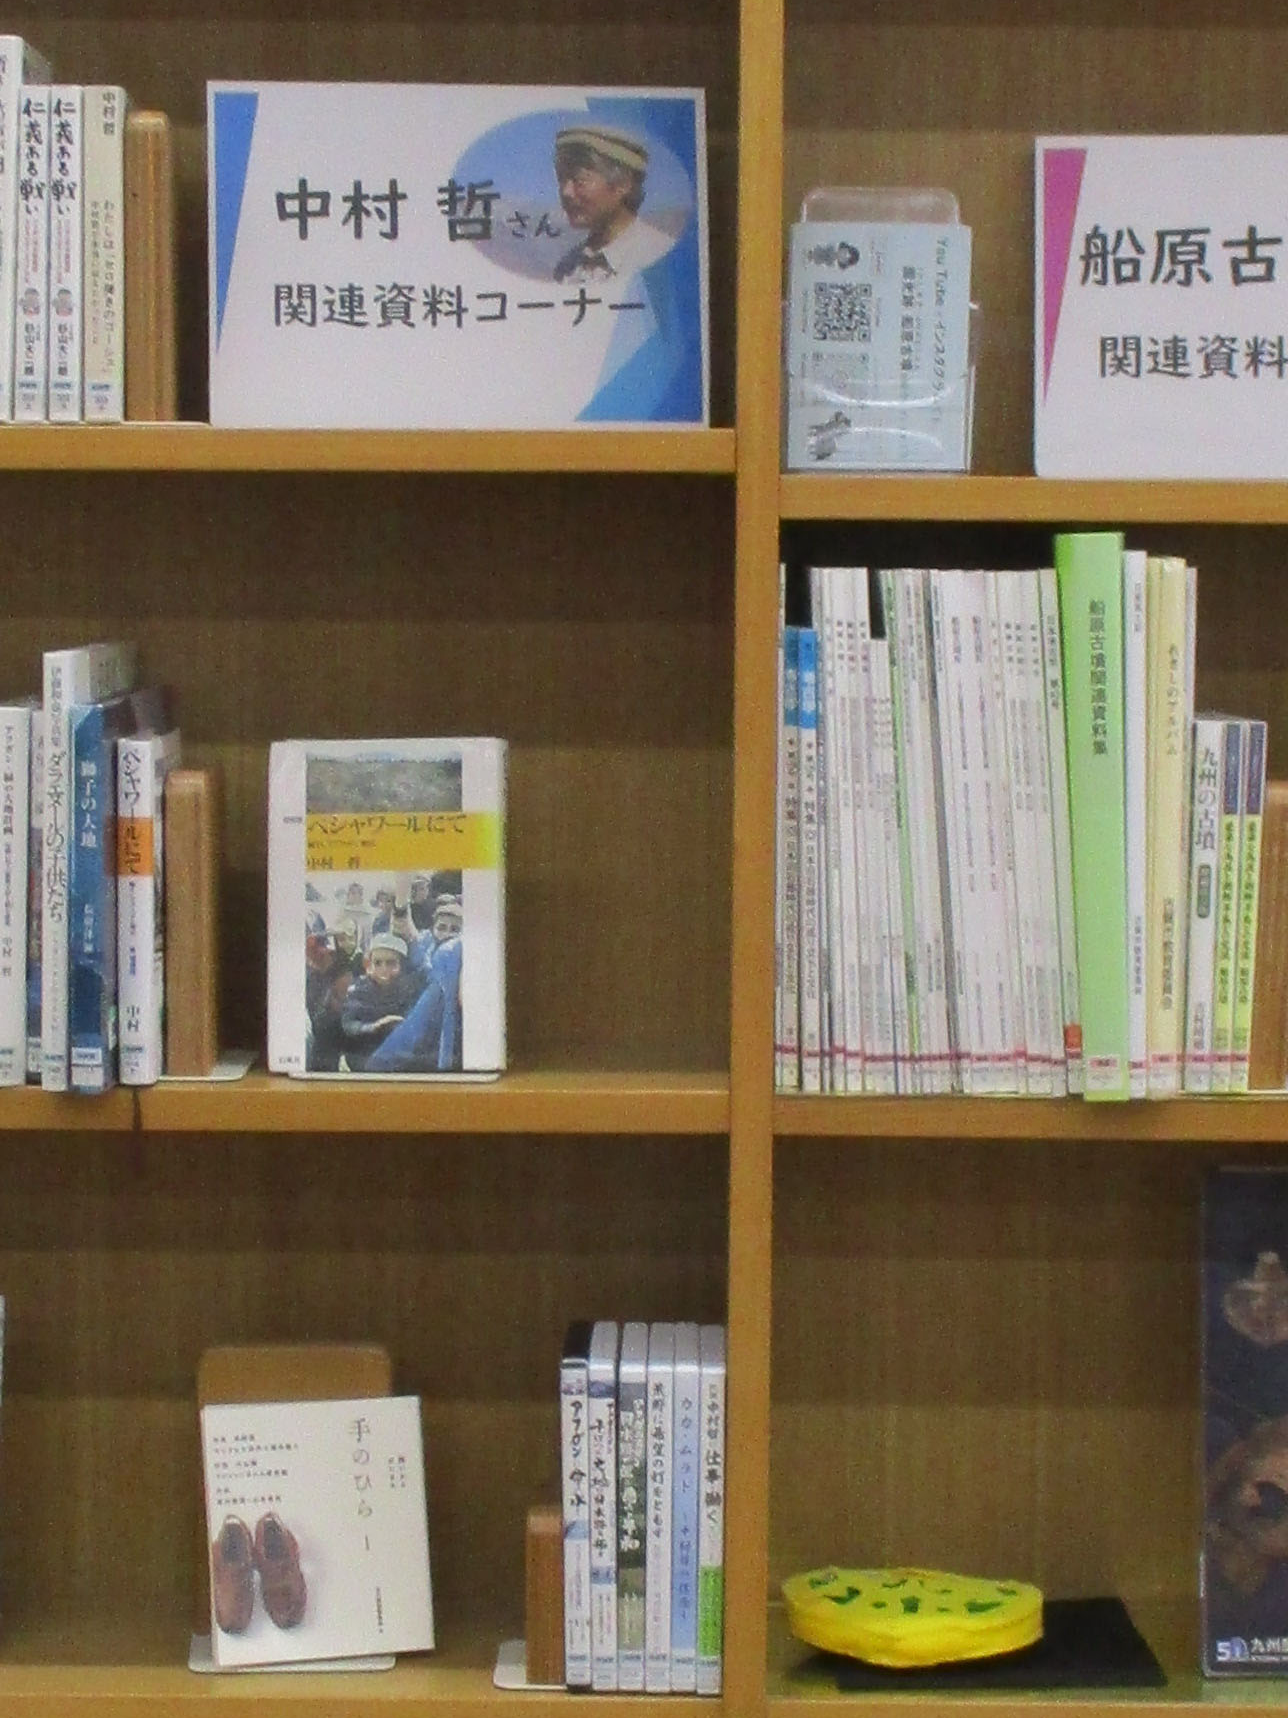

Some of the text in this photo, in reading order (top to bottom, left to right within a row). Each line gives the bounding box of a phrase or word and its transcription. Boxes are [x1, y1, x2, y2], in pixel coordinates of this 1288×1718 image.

[274, 283, 646, 329] 関連資料コーナー
